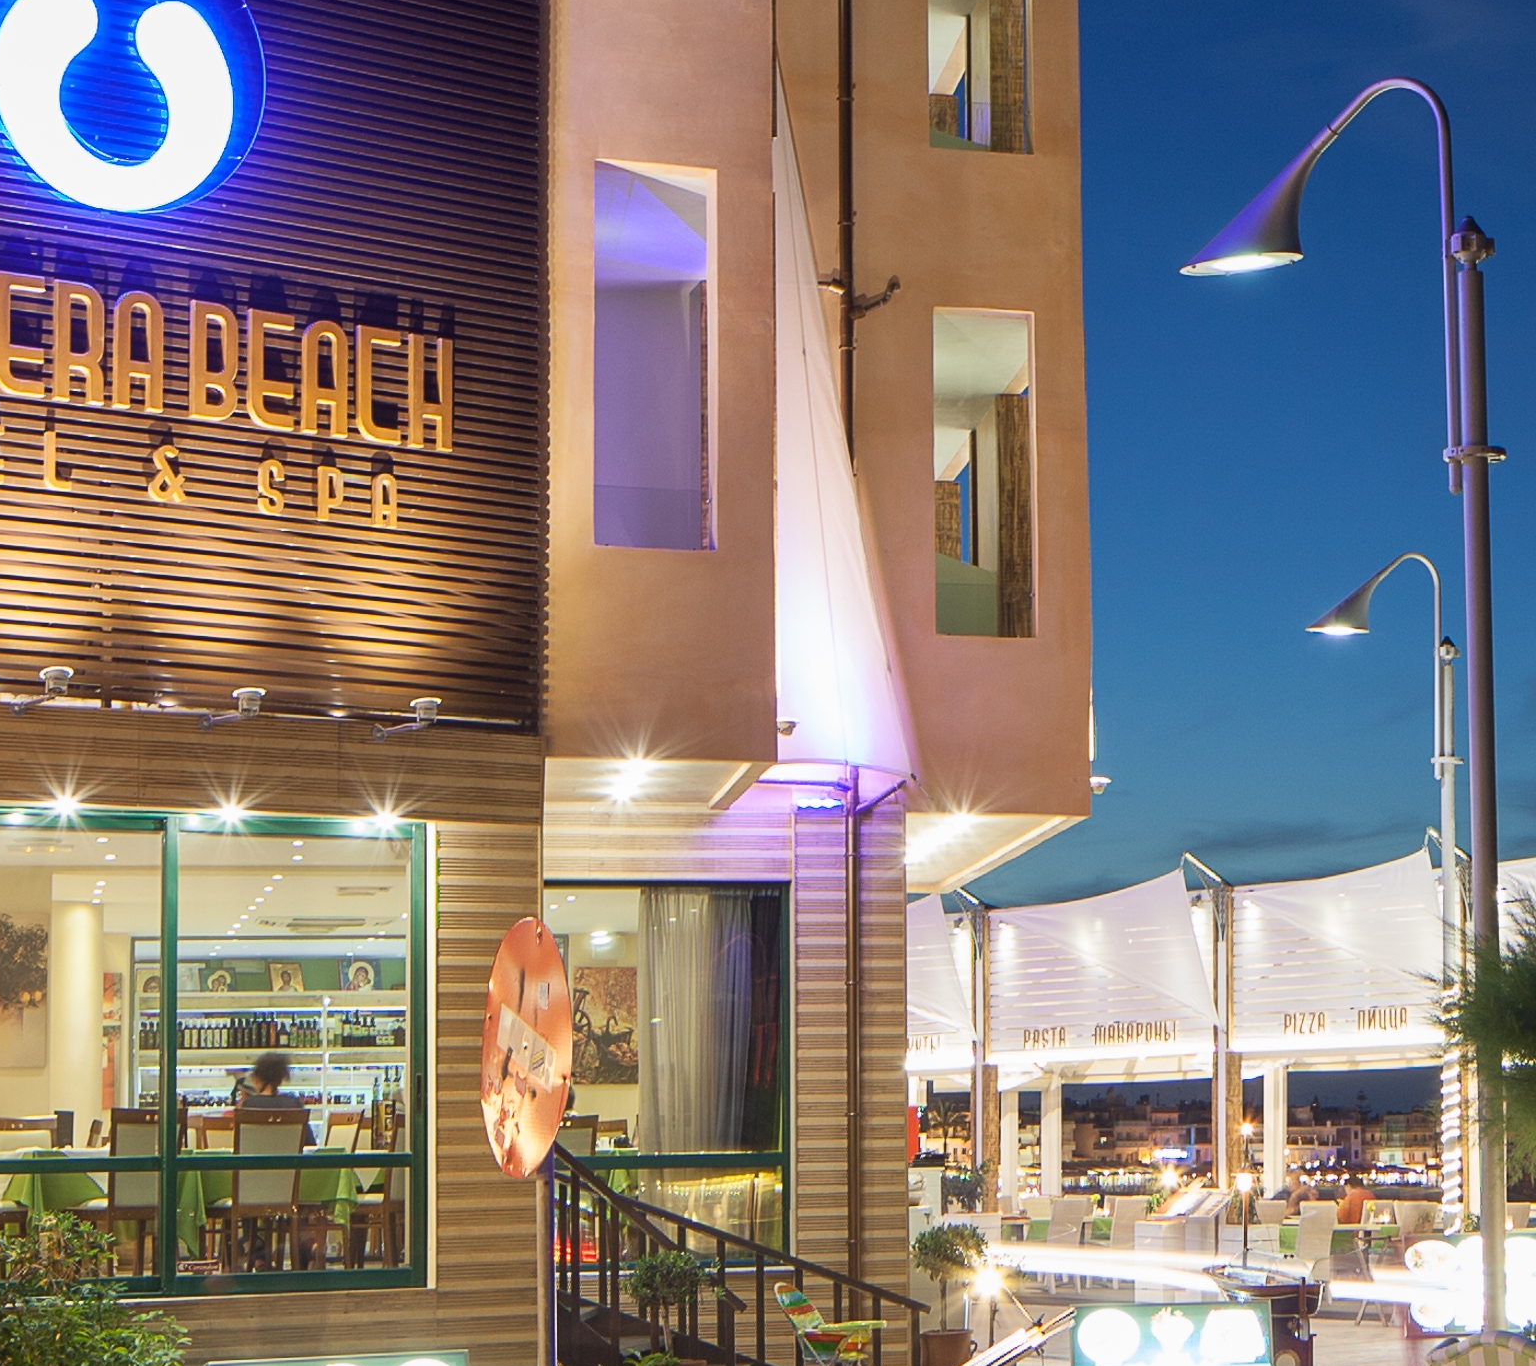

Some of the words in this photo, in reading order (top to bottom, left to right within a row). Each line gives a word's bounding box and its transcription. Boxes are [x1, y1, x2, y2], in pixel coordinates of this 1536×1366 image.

[188, 299, 454, 452] BEACH
[148, 445, 186, 503] &
[257, 459, 398, 528] SPA
[1023, 1027, 1067, 1049] PASTA
[1094, 1020, 1177, 1046] МАКАРОНЫ
[1283, 1011, 1326, 1035] PIZZA
[1357, 1007, 1407, 1032] ПИЦЦА
